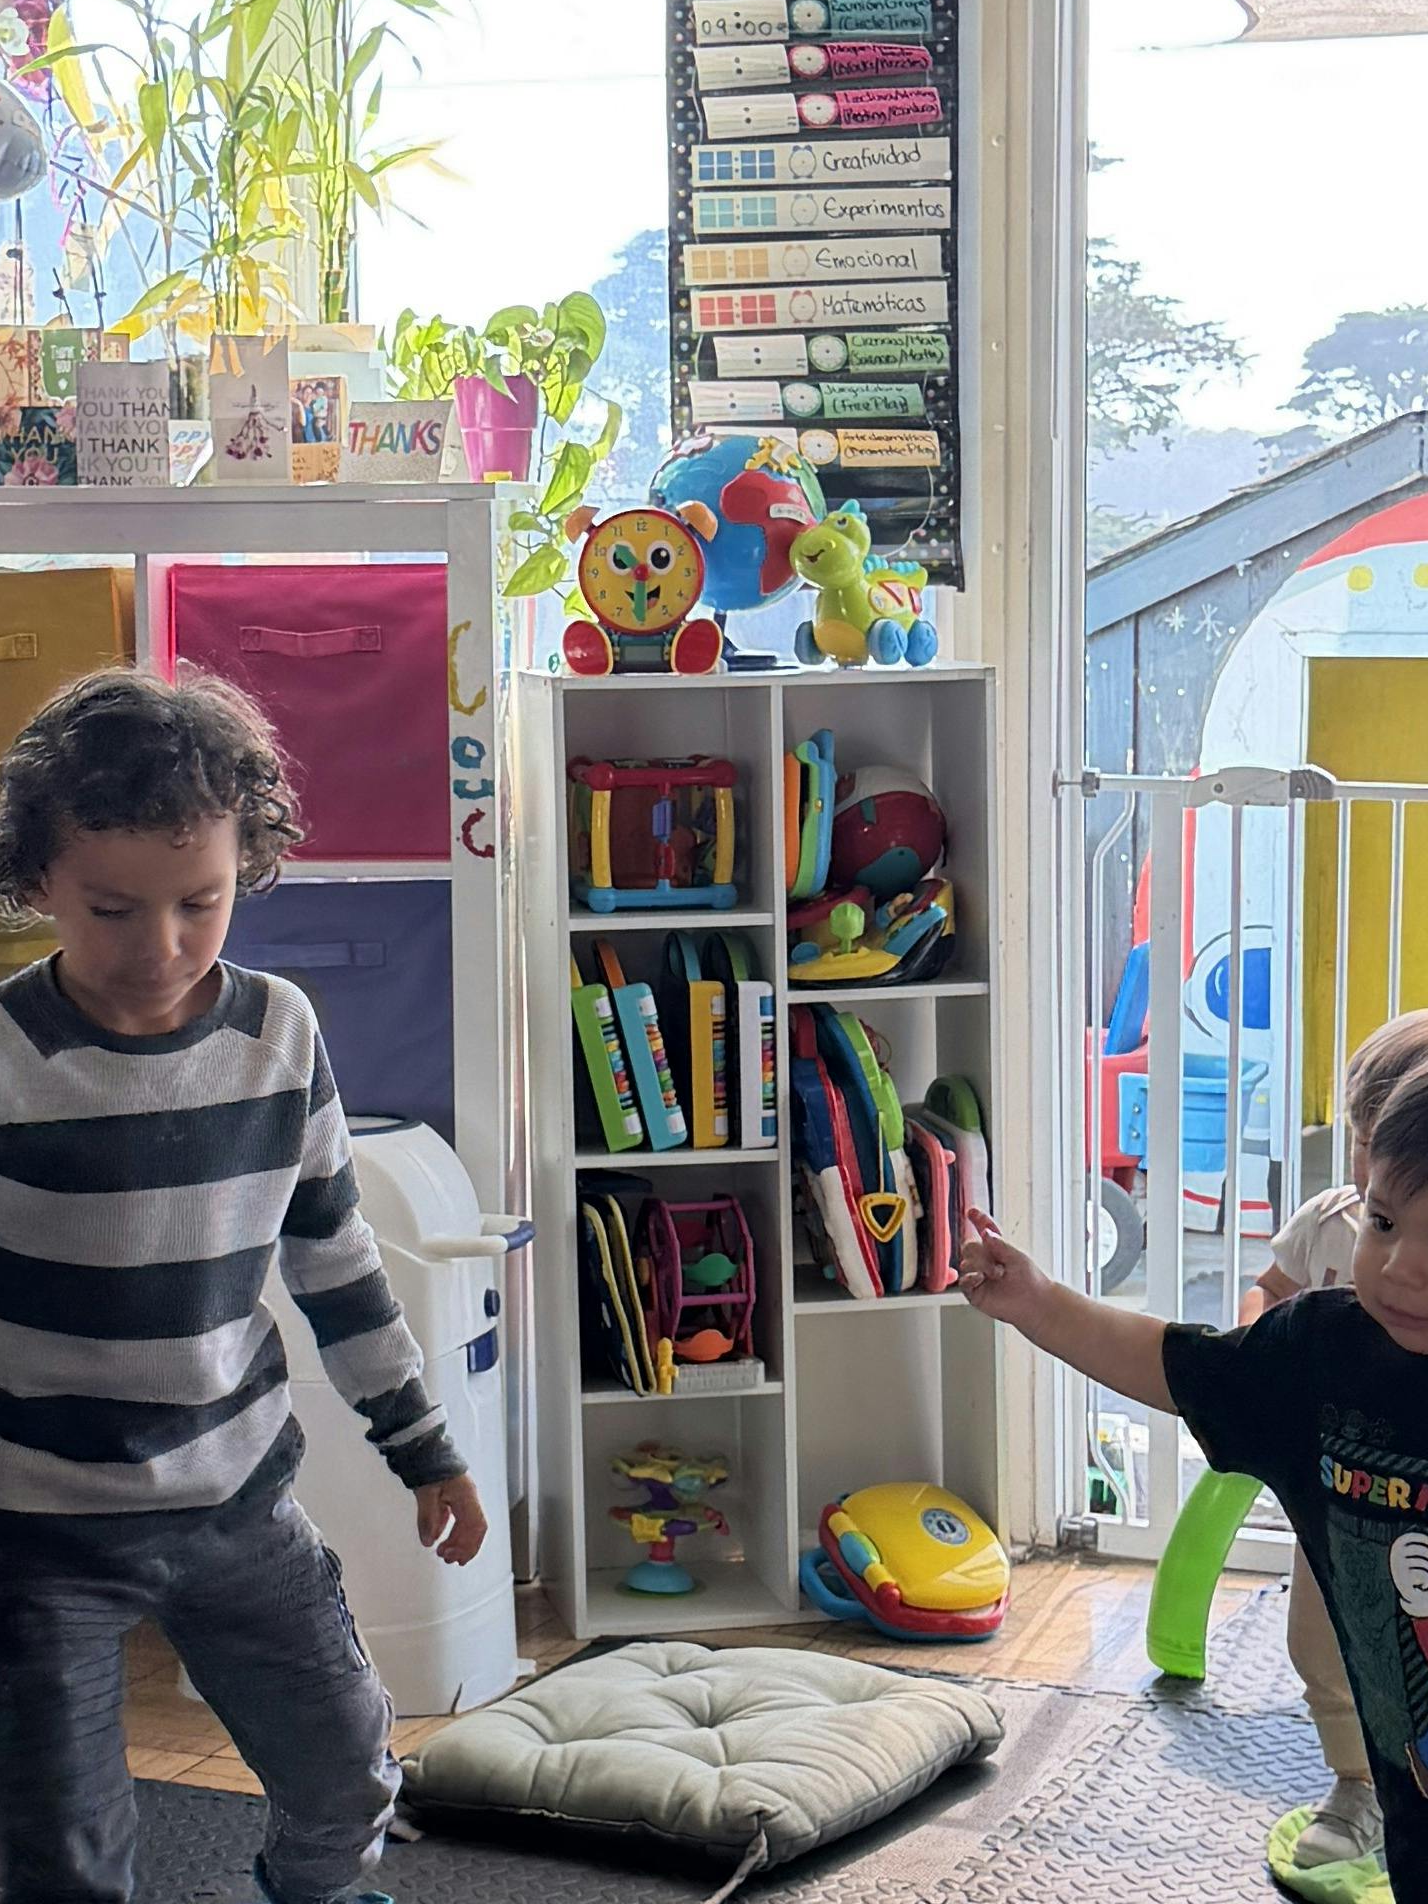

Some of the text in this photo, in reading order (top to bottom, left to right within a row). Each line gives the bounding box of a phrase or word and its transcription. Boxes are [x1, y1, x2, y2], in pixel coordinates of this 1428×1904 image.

[823, 142, 921, 171] Creatividad
[823, 196, 946, 222] Experimentos
[815, 248, 918, 270] Emocional
[822, 290, 927, 316] Matemáticas
[348, 419, 444, 457] THANKS
[87, 438, 159, 454] THANK
[611, 525, 623, 537] 11
[635, 520, 648, 532] 12
[664, 525, 670, 536] 1
[677, 545, 685, 556] 2
[591, 568, 599, 578] 9
[684, 567, 691, 577] 3
[599, 590, 607, 600] 8
[677, 590, 684, 599] 4
[615, 607, 623, 617] 7
[661, 605, 669, 615] 5
[1319, 1454, 1411, 1510] SUPER
